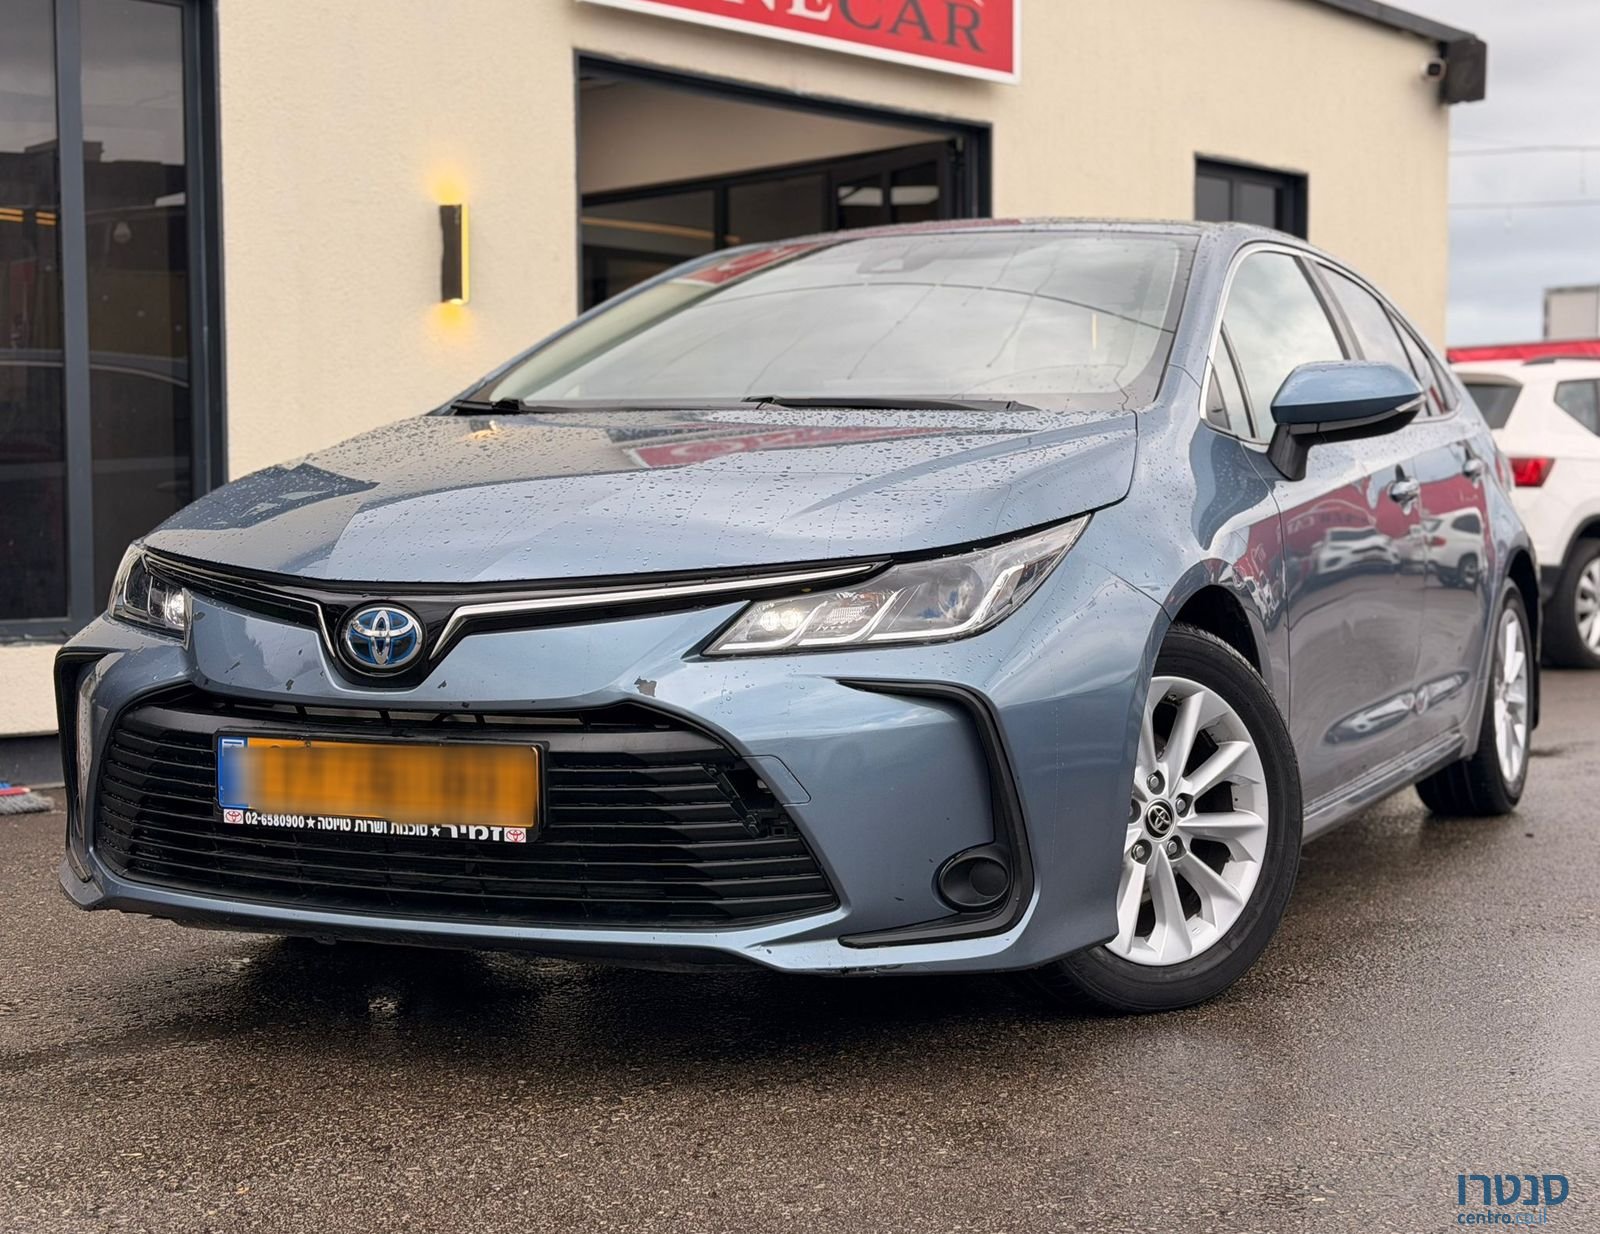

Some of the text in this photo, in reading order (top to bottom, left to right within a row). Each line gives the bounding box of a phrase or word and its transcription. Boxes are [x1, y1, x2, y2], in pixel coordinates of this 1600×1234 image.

[722, 0, 985, 53] CAR
[245, 811, 504, 842] זמיר סוכנות ושרות טויוטה 02-6580900
